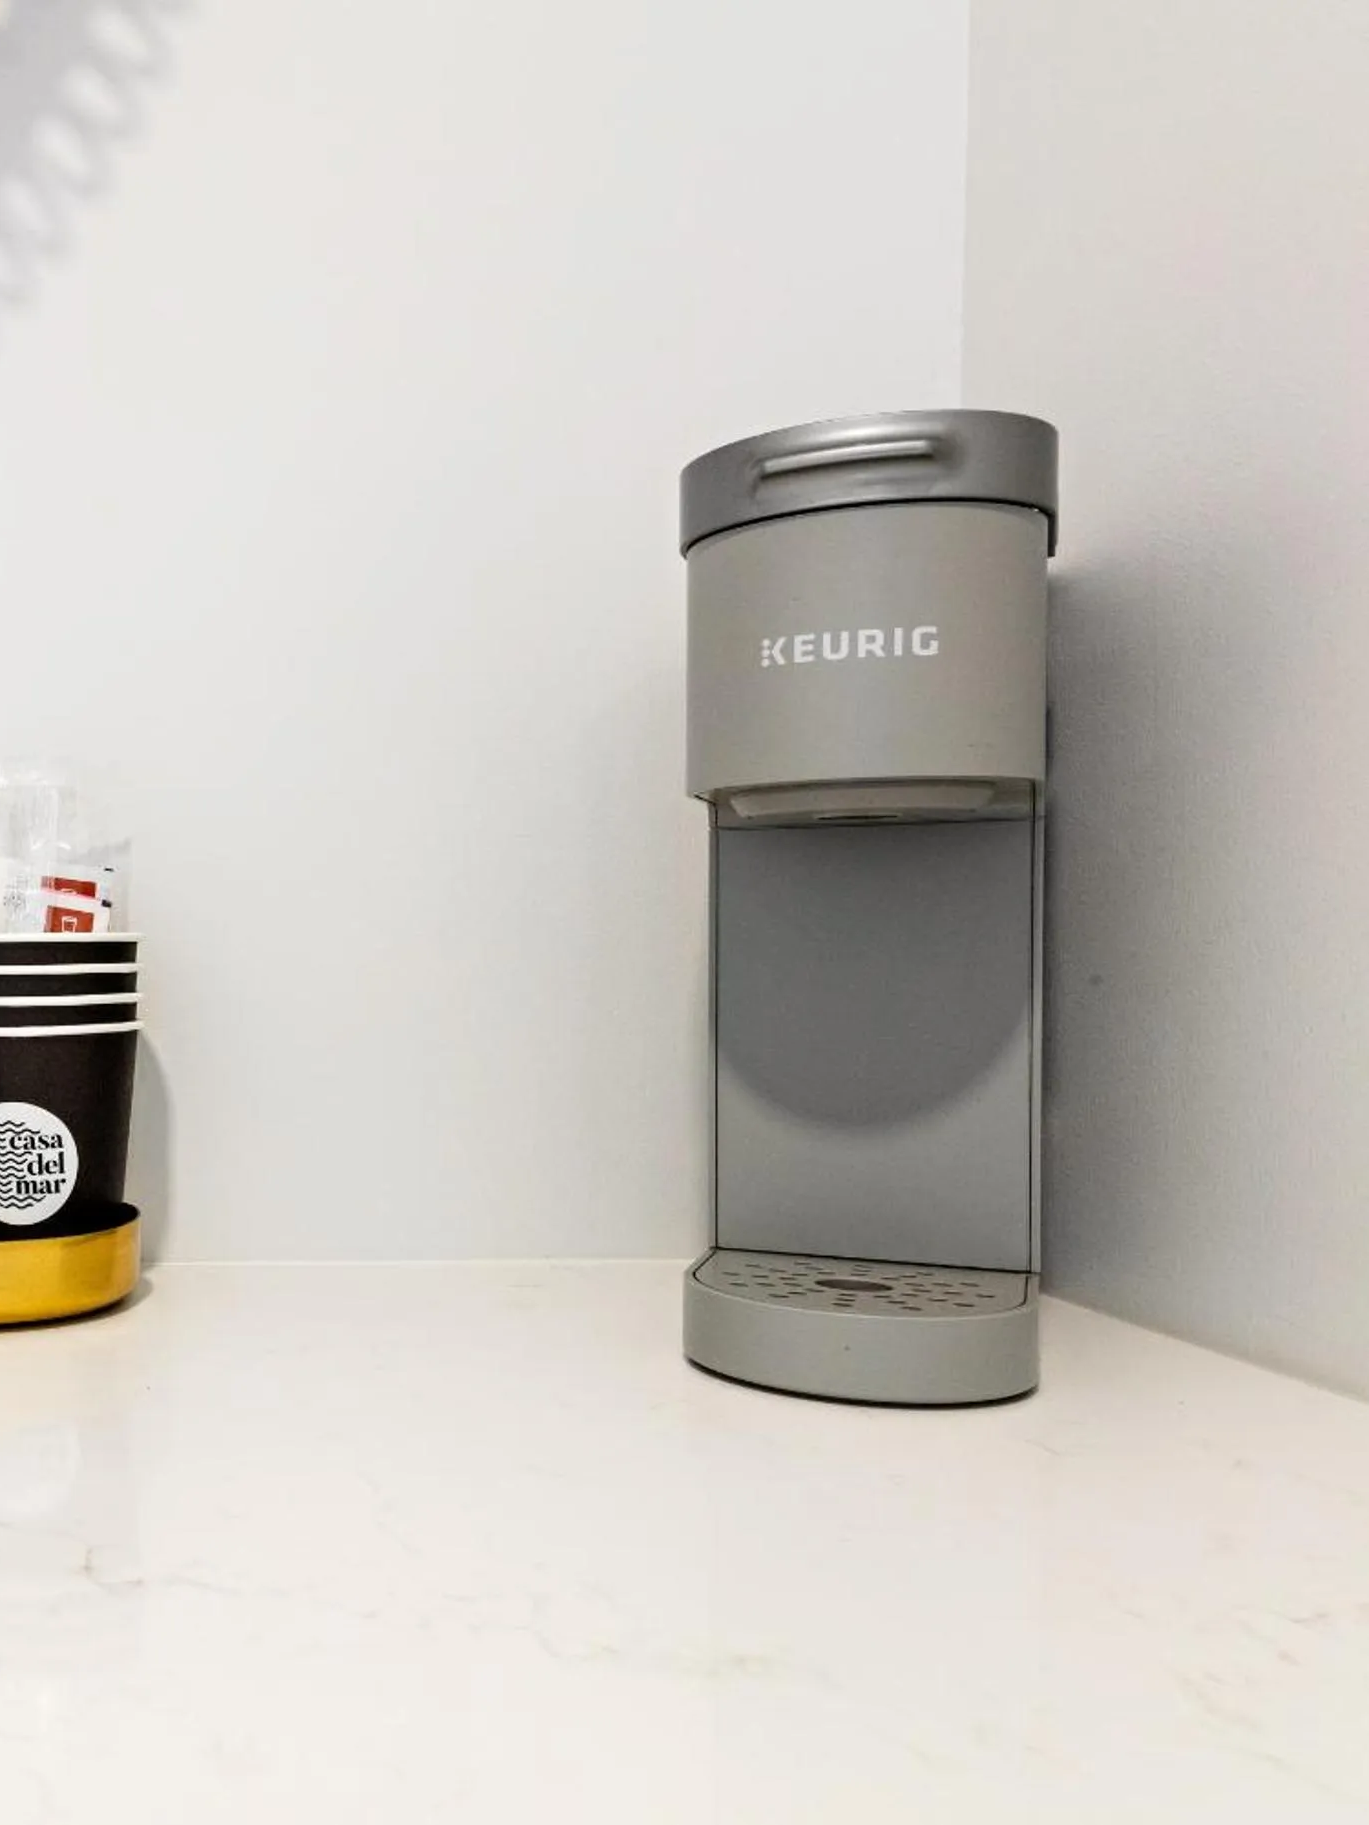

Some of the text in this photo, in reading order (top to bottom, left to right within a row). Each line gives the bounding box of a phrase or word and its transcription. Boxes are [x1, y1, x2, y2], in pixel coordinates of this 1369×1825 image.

[760, 625, 940, 668] KEURIG
[9, 1133, 63, 1150] casa
[27, 1151, 65, 1175] del
[15, 1178, 67, 1195] mar
